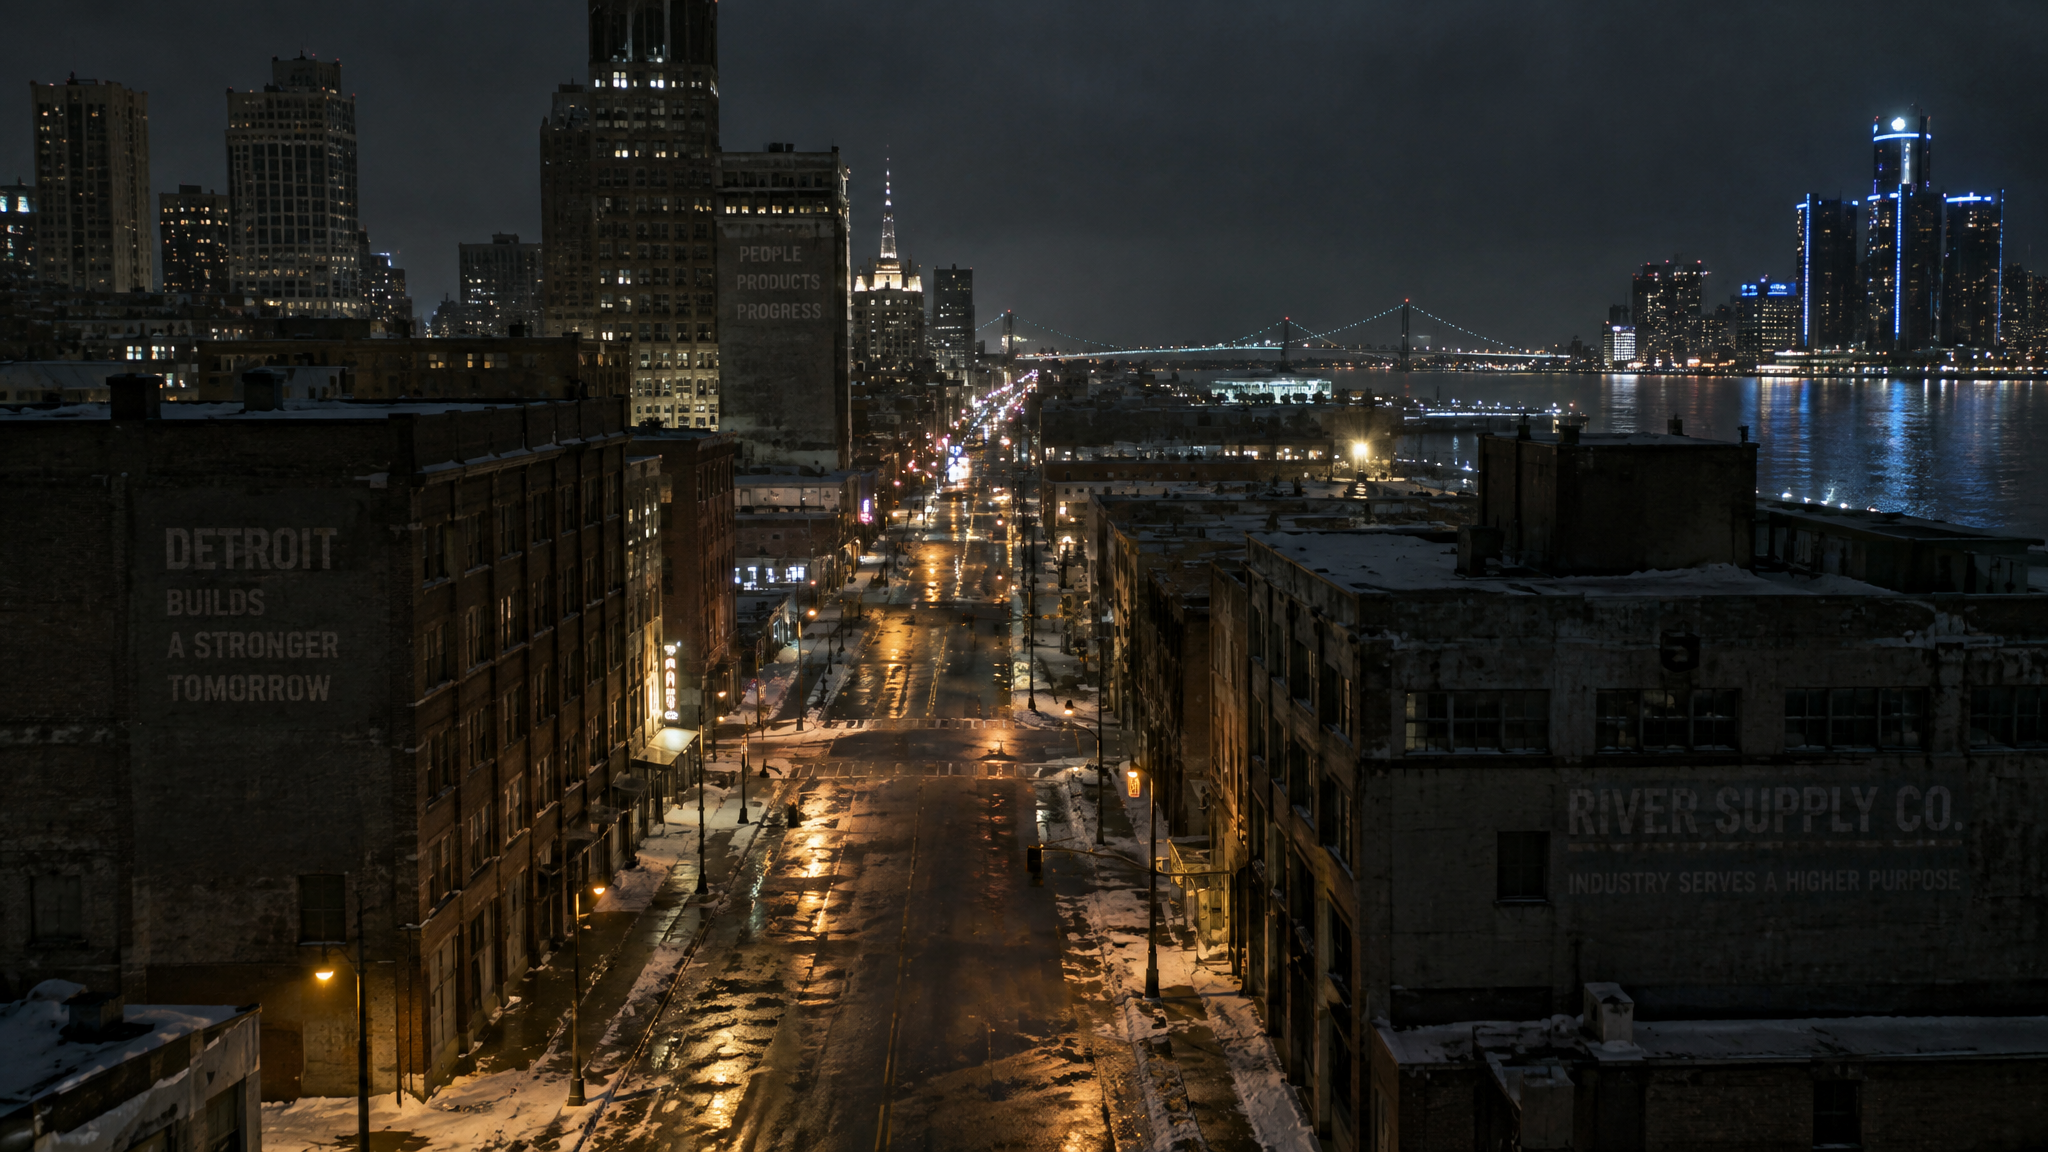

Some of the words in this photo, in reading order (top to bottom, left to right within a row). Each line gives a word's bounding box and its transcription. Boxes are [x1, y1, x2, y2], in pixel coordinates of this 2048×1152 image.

[740, 246, 802, 262] PEOPLE
[737, 274, 820, 290] PRODUCTS
[738, 303, 822, 320] PROGRESS
[166, 527, 338, 570] DETROIT
[166, 588, 265, 616] BUILDS
[167, 632, 185, 658] A
[194, 631, 339, 658] STRONGER
[168, 674, 331, 701] TOMORROW
[1568, 788, 1698, 835] RIVER
[1715, 786, 1879, 834] SUPPLY
[1896, 785, 1963, 832] CO.
[1568, 872, 1671, 894] INDUSTRY
[1679, 871, 1756, 893] SERVES
[1764, 871, 1778, 892] A
[1786, 870, 1860, 892] HIGHER
[1869, 869, 1961, 891] PURPOSE
